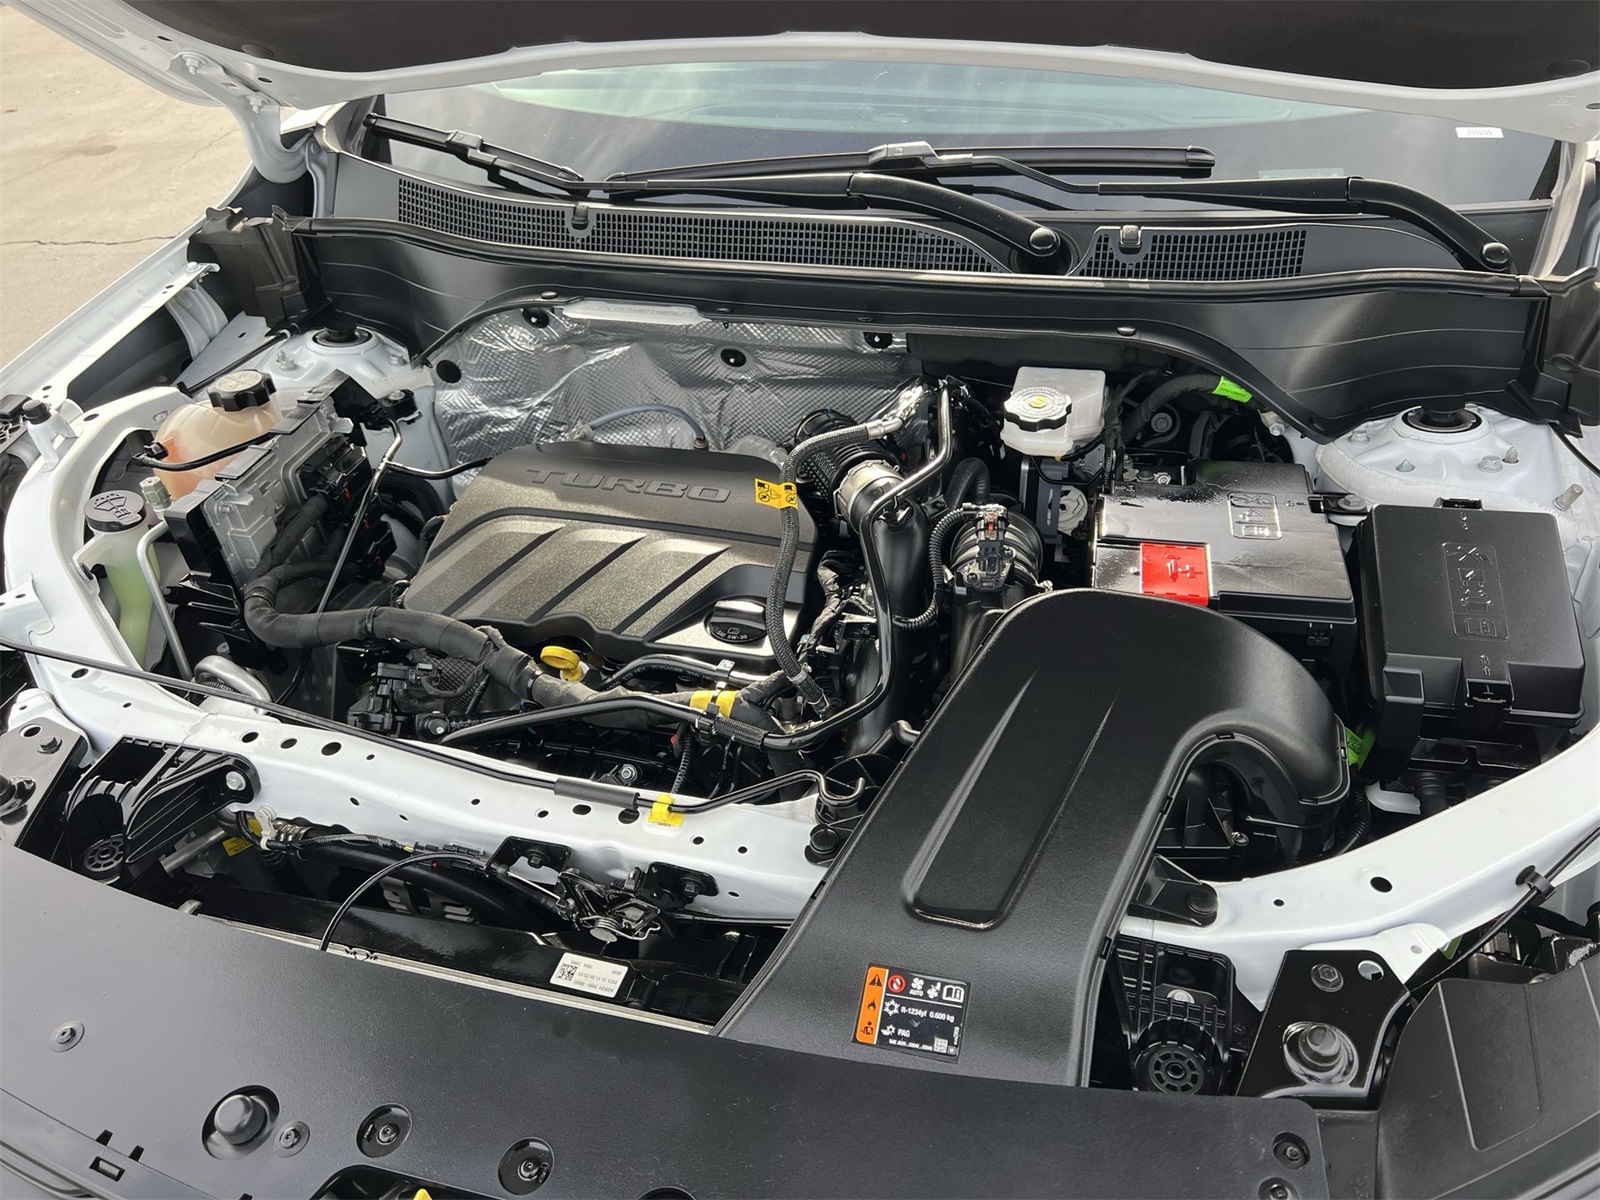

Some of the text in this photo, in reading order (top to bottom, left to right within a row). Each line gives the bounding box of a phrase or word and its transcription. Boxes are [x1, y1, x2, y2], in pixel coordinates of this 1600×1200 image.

[526, 468, 732, 503] TURBO
[909, 989, 924, 997] AUTO
[900, 1006, 927, 1018] R-1234yf
[946, 1012, 955, 1023] kg
[897, 1028, 911, 1038] PAG
